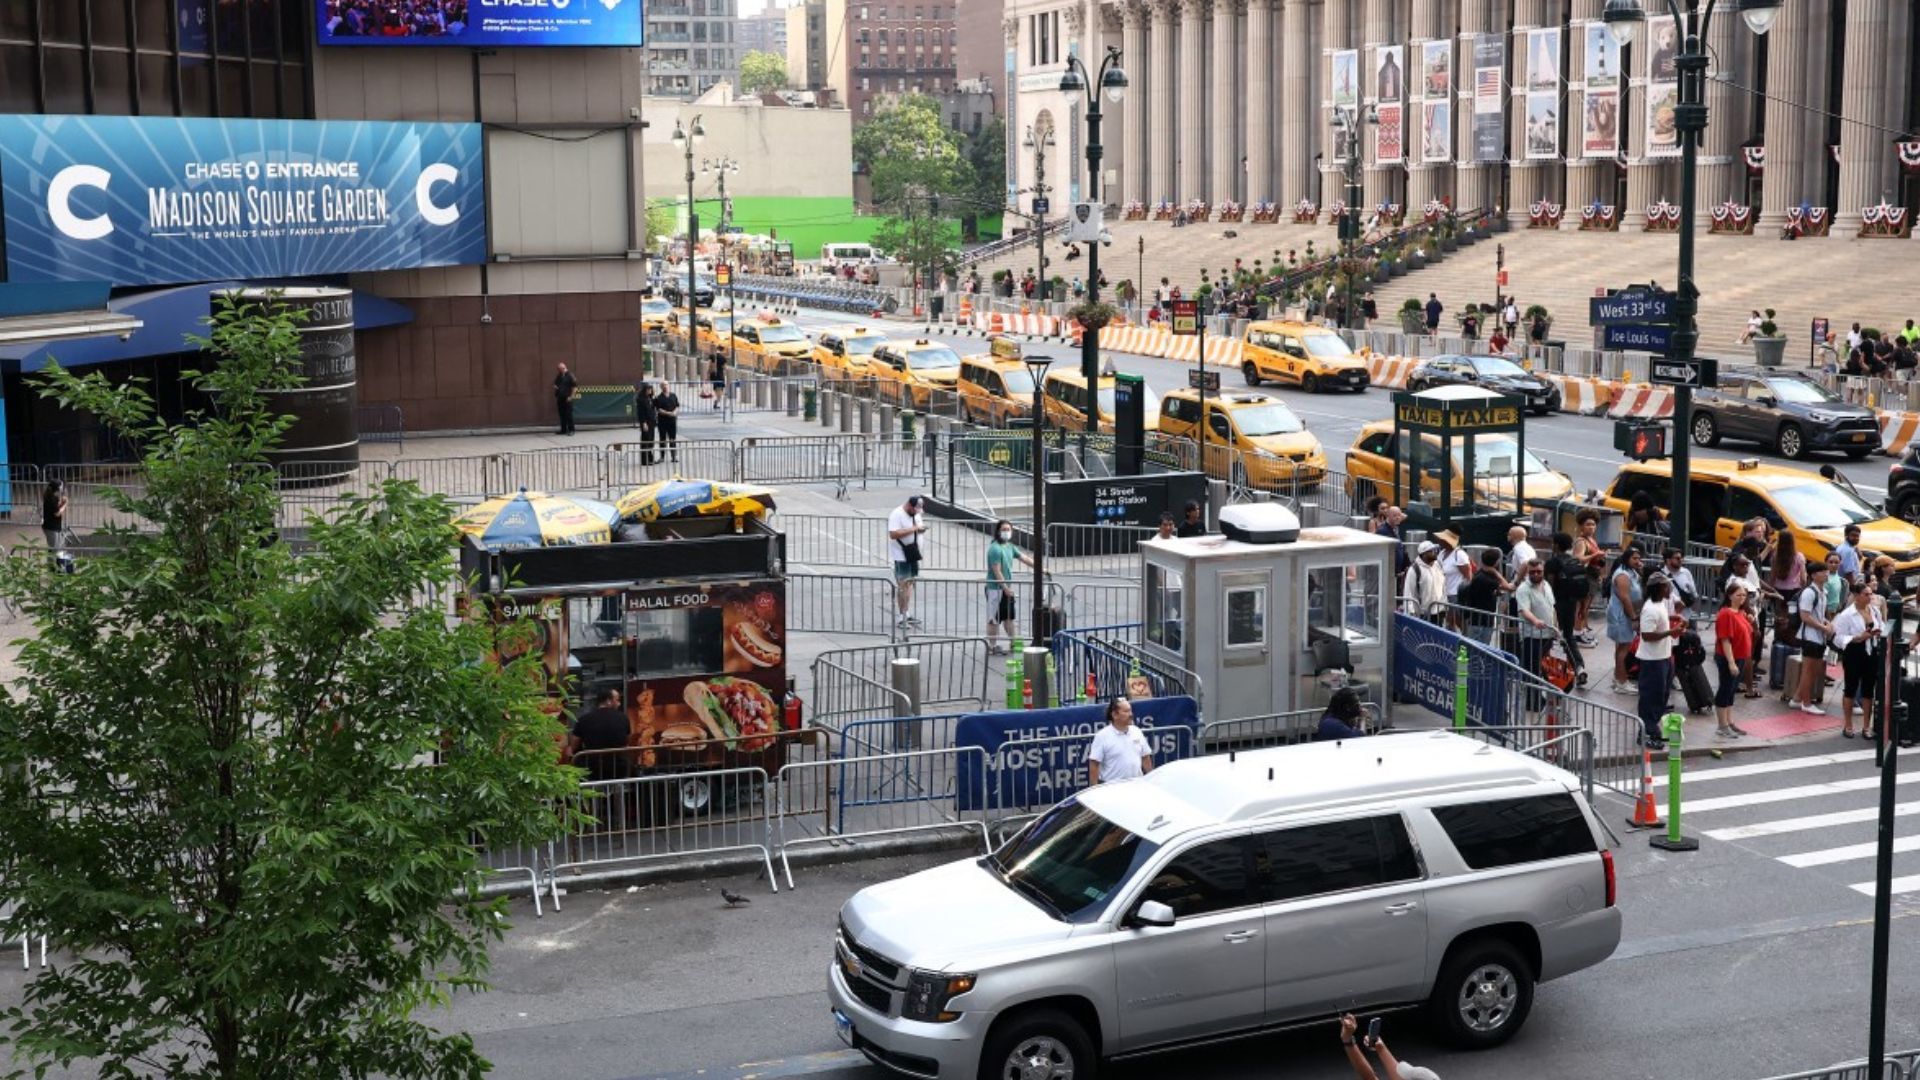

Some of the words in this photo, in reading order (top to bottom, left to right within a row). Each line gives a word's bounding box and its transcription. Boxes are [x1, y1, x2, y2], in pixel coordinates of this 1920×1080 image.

[185, 163, 242, 179] CHASE
[267, 162, 359, 177] ENTRANCE
[47, 164, 114, 240] C
[415, 163, 461, 226] C
[148, 187, 241, 228] MADISON
[247, 185, 317, 226] SQUARE
[191, 231, 210, 240] THE
[215, 229, 257, 238] WORLD'S
[261, 229, 286, 237] MOST
[290, 227, 325, 236] FAMOUS
[1599, 304, 1628, 318] West
[1631, 301, 1652, 316] 33rd
[1654, 302, 1667, 315] St
[1611, 330, 1625, 343] Joe
[1627, 331, 1649, 344] Louis
[1400, 405, 1428, 424] TAXI
[1454, 408, 1495, 425] TAXI
[1095, 488, 1107, 497] 34
[1110, 486, 1136, 496] Street
[1095, 498, 1116, 506] Penn
[1118, 495, 1147, 505] Station
[629, 597, 671, 609] HALAL
[673, 593, 709, 606] FOOD
[1403, 673, 1425, 699] THE
[1425, 686, 1483, 720] GARN
[1003, 726, 1049, 742] THE
[1055, 715, 1154, 739] WOR'S
[983, 746, 1061, 772] MOST
[1067, 733, 1177, 765] FAUS
